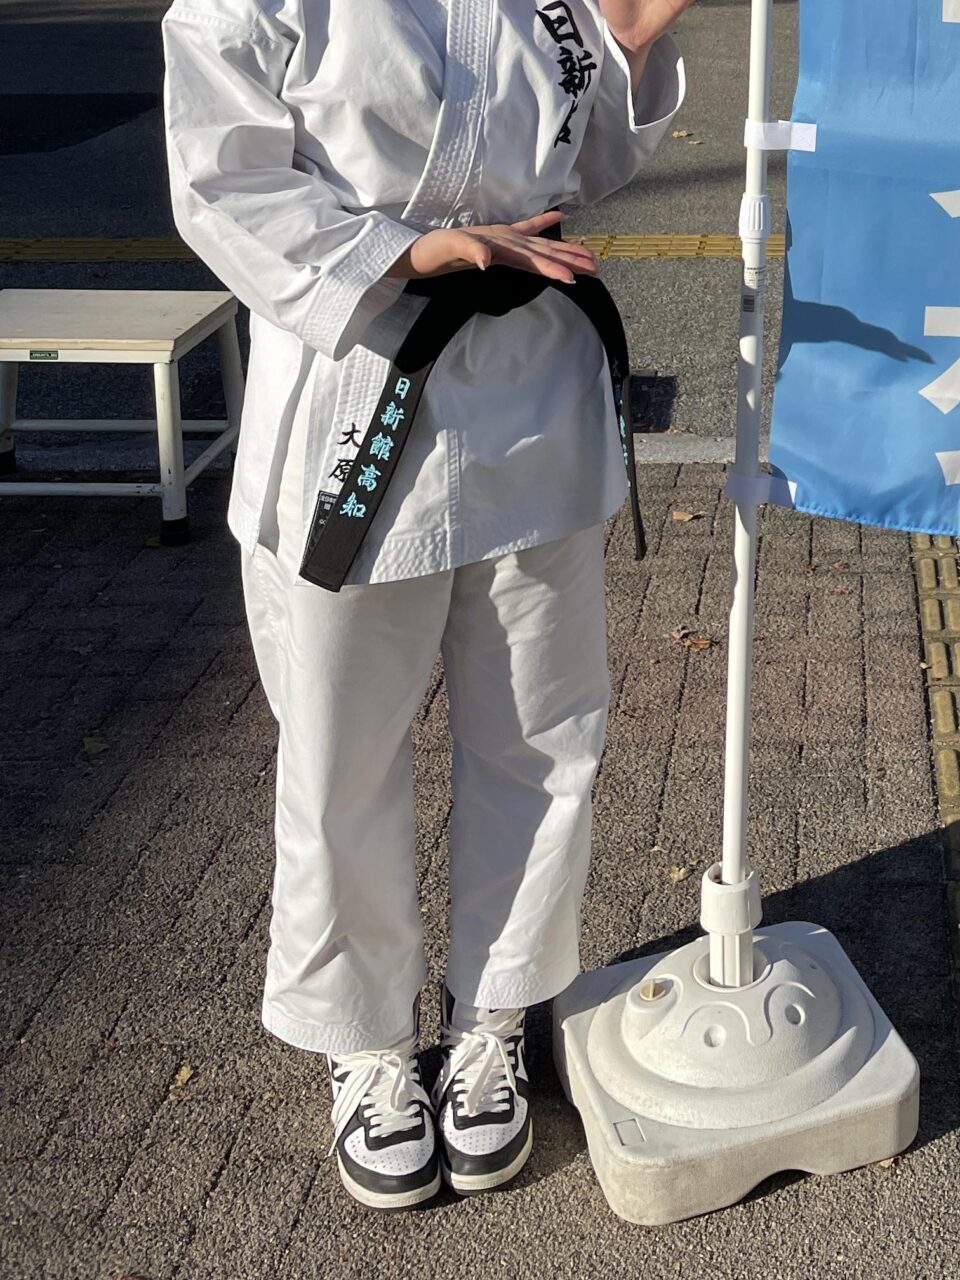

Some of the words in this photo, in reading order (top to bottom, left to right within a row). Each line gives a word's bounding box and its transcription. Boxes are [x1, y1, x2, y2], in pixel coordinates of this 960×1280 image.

[339, 376, 411, 519] 日新館高知
